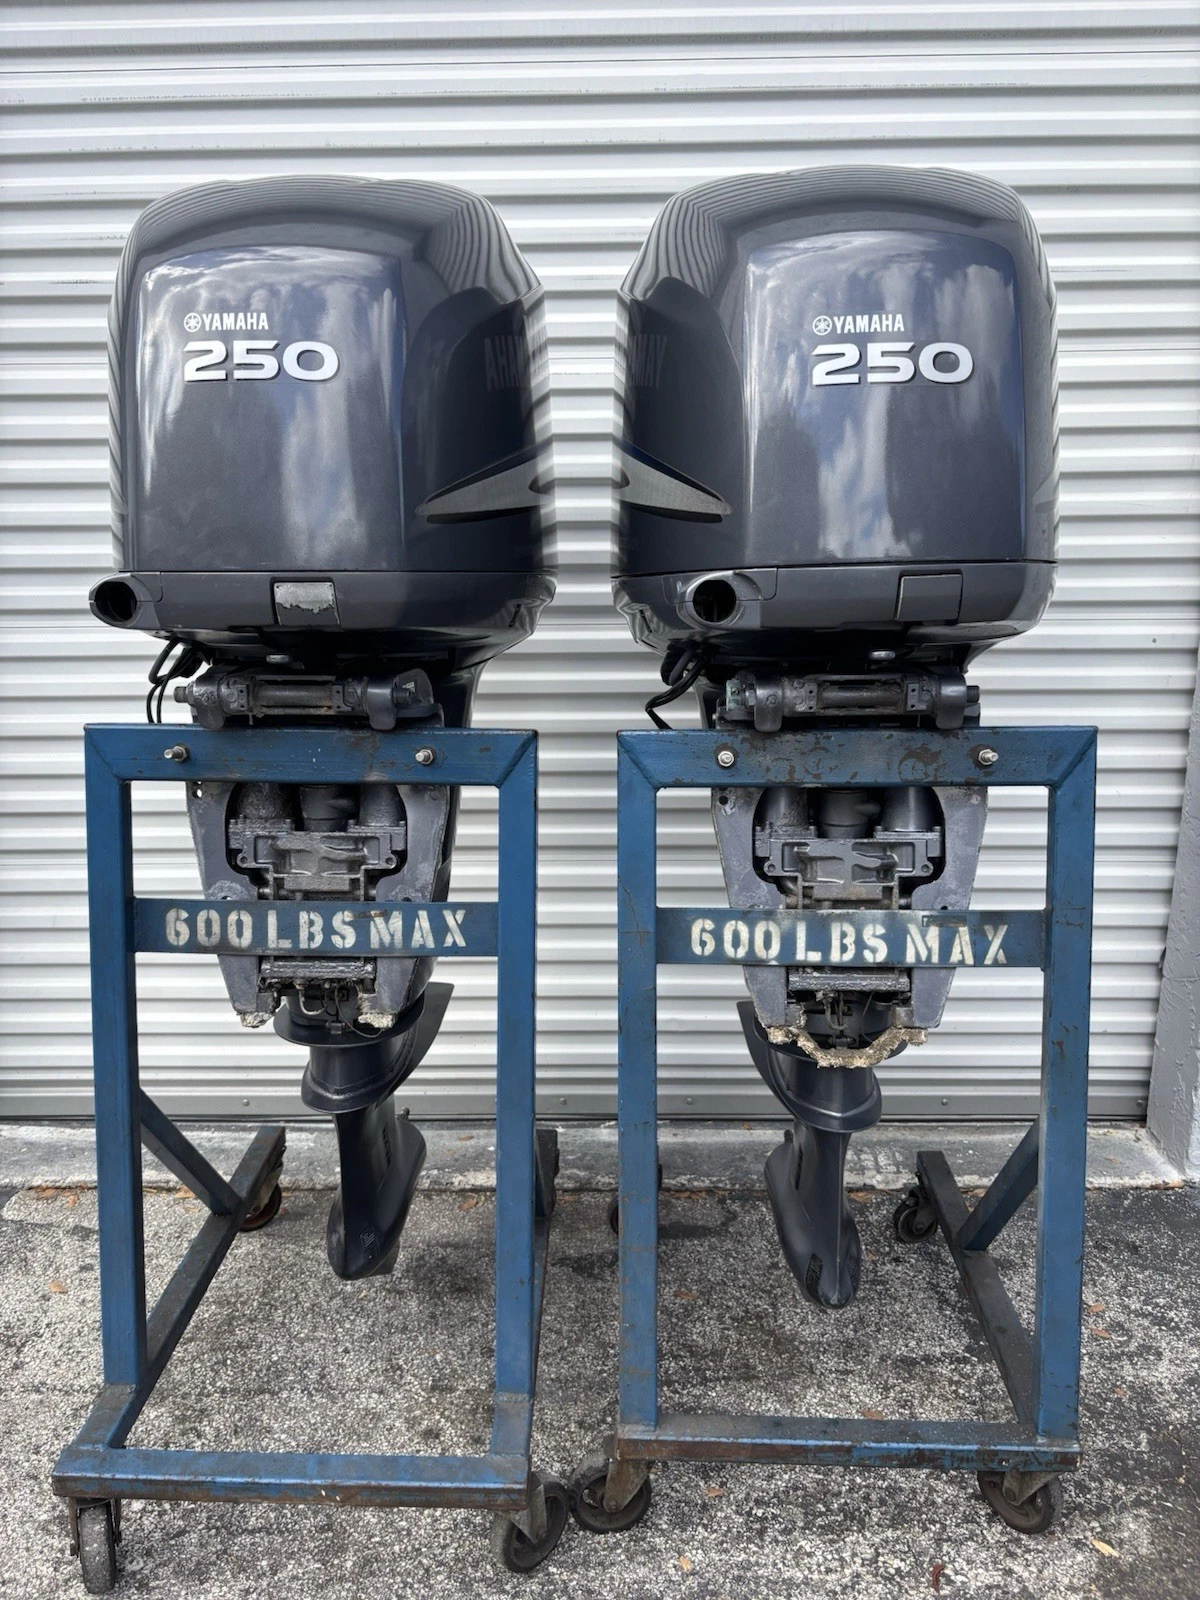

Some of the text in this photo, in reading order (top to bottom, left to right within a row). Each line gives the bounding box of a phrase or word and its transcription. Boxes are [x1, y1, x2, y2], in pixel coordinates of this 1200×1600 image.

[203, 312, 269, 331] YAMAHA
[834, 314, 905, 334] YAMAHA
[183, 340, 340, 382] 250
[811, 342, 974, 386] 250
[165, 907, 467, 949] 600 LBS MAX
[690, 917, 1007, 965] 600 LBS MAX
